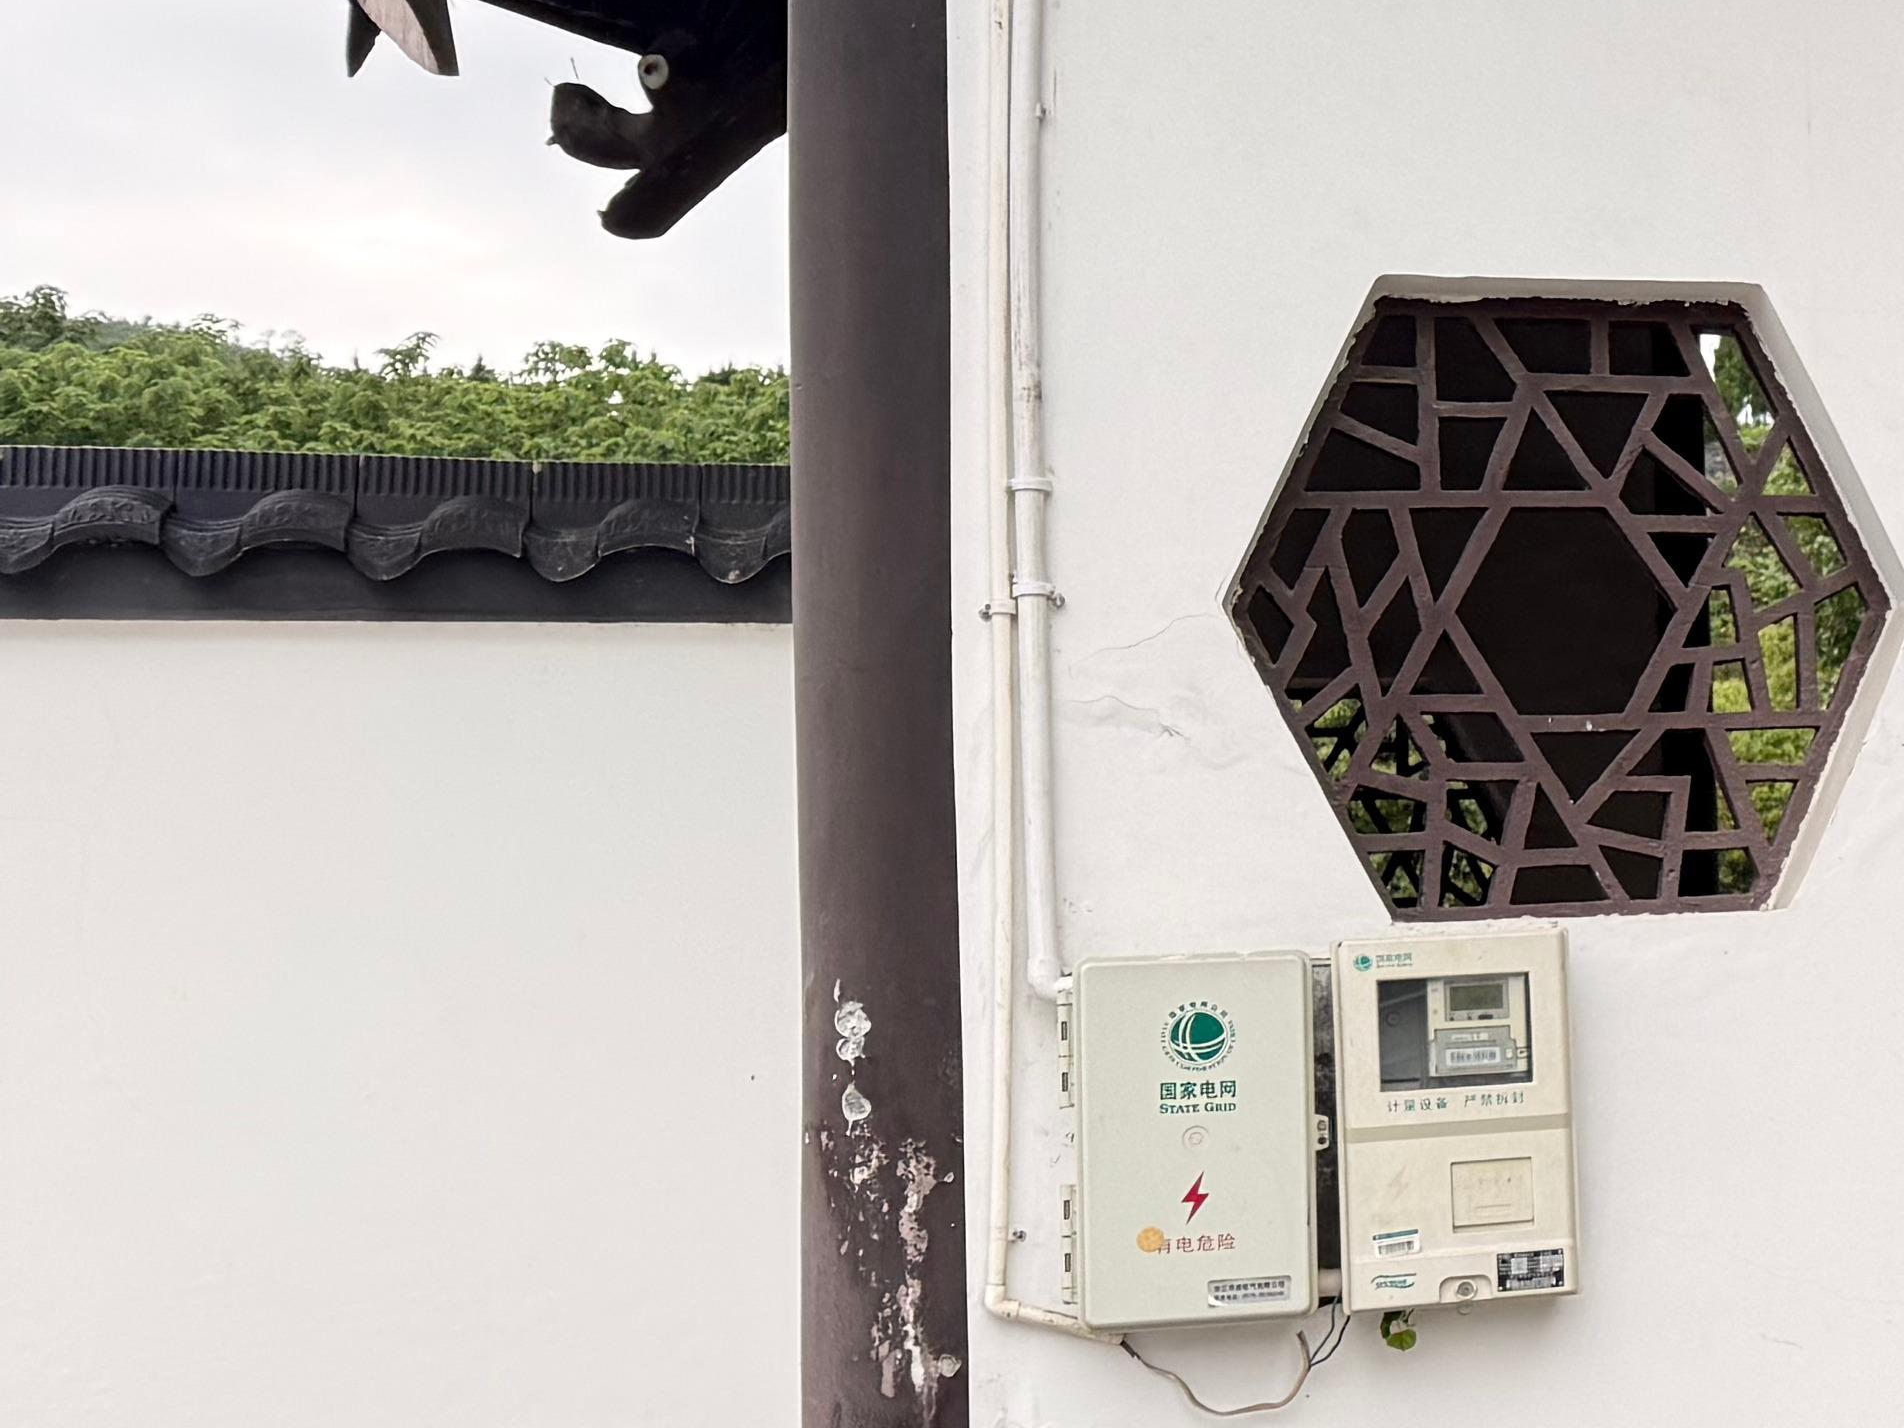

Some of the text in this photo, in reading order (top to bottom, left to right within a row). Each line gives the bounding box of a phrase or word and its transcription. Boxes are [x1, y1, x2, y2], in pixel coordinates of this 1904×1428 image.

[1160, 1080, 1236, 1100] 国家电网
[1159, 1102, 1237, 1114] STATE GRID
